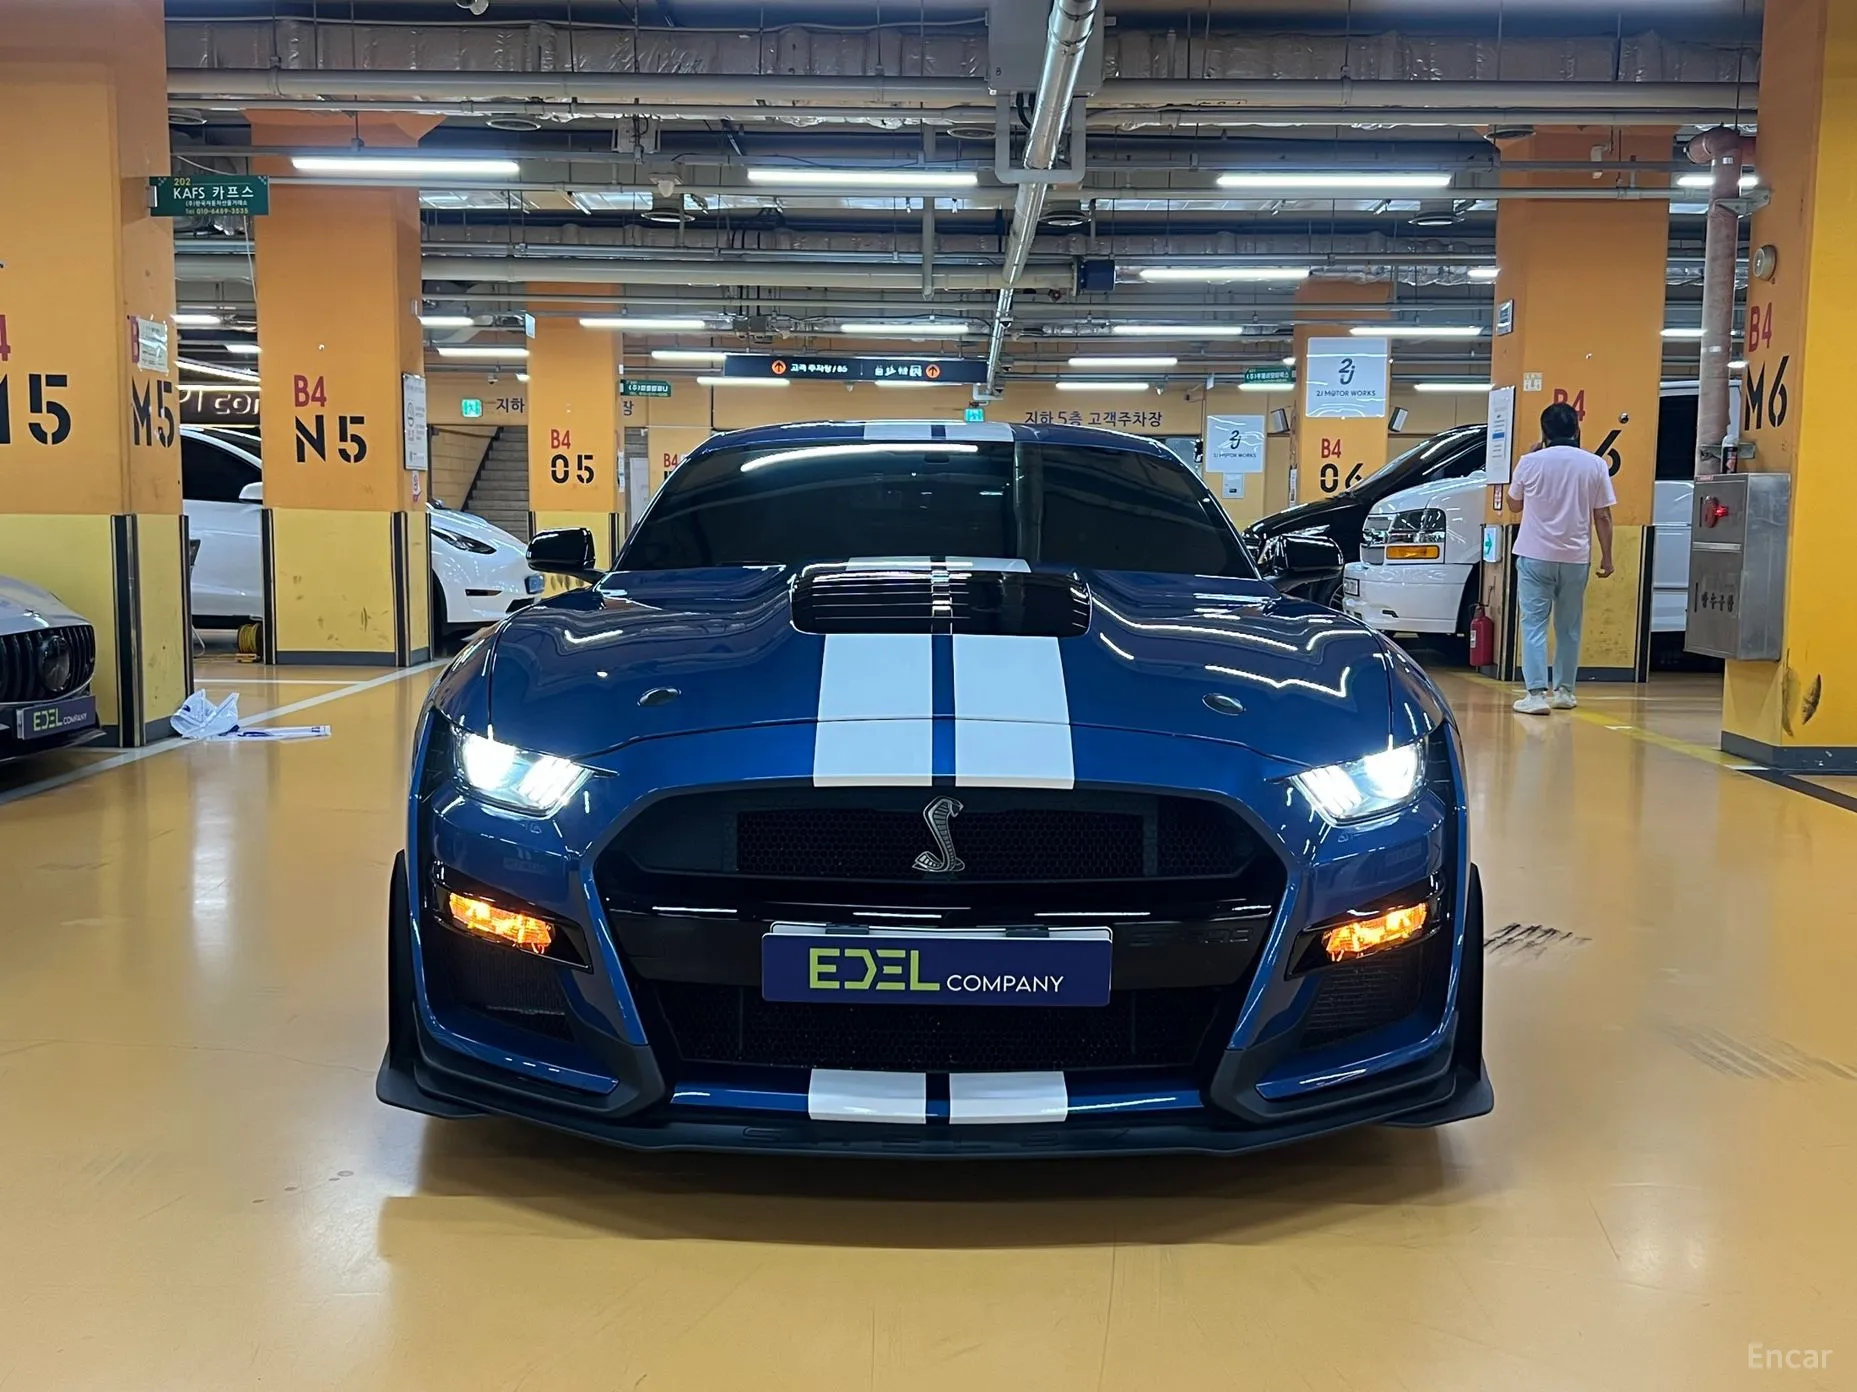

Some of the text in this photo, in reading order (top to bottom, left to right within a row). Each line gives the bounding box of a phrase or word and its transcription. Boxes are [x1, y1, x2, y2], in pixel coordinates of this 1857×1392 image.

[174, 178, 191, 186] 202
[173, 186, 254, 200] KAFS 카프스
[1748, 302, 1772, 352] B4
[293, 376, 327, 407] B4
[1744, 355, 1790, 431] M6
[131, 376, 175, 448] M5
[496, 398, 525, 413] 지하
[1024, 411, 1162, 427] 지하 5층 고객주차장
[295, 414, 367, 463] N5
[550, 429, 571, 449] B4
[1321, 438, 1341, 458] B4
[663, 453, 678, 468] B4
[33, 708, 87, 731] EDEL COMPANY
[810, 948, 1064, 992] EDEL COMPANY
